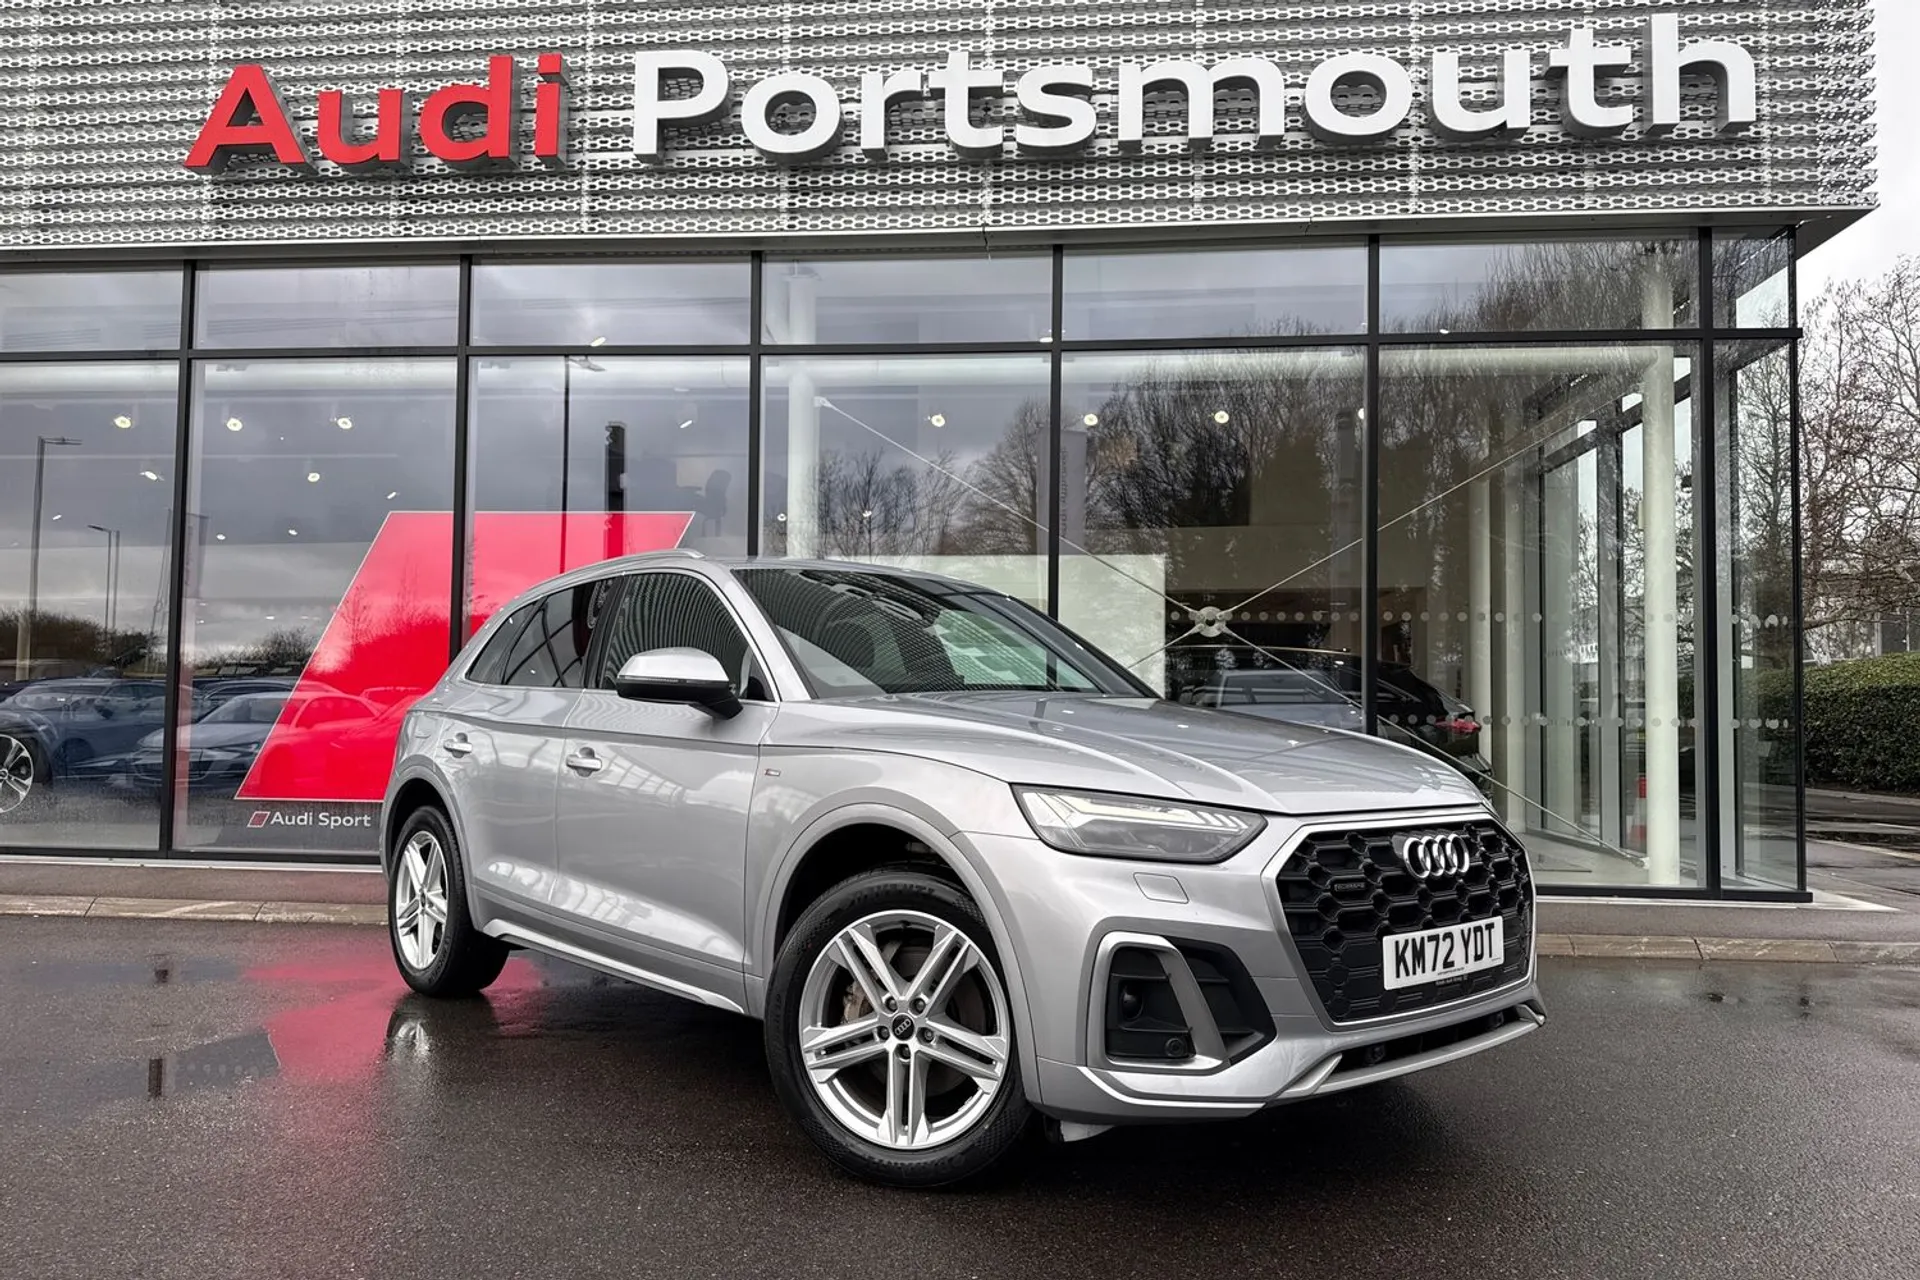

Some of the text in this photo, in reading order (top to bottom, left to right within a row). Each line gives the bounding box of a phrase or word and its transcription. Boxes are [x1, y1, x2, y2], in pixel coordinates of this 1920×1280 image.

[186, 13, 1757, 168] Audi Portsmouth
[270, 811, 371, 829] Audi Sport
[1395, 922, 1495, 979] KM72 YDT
